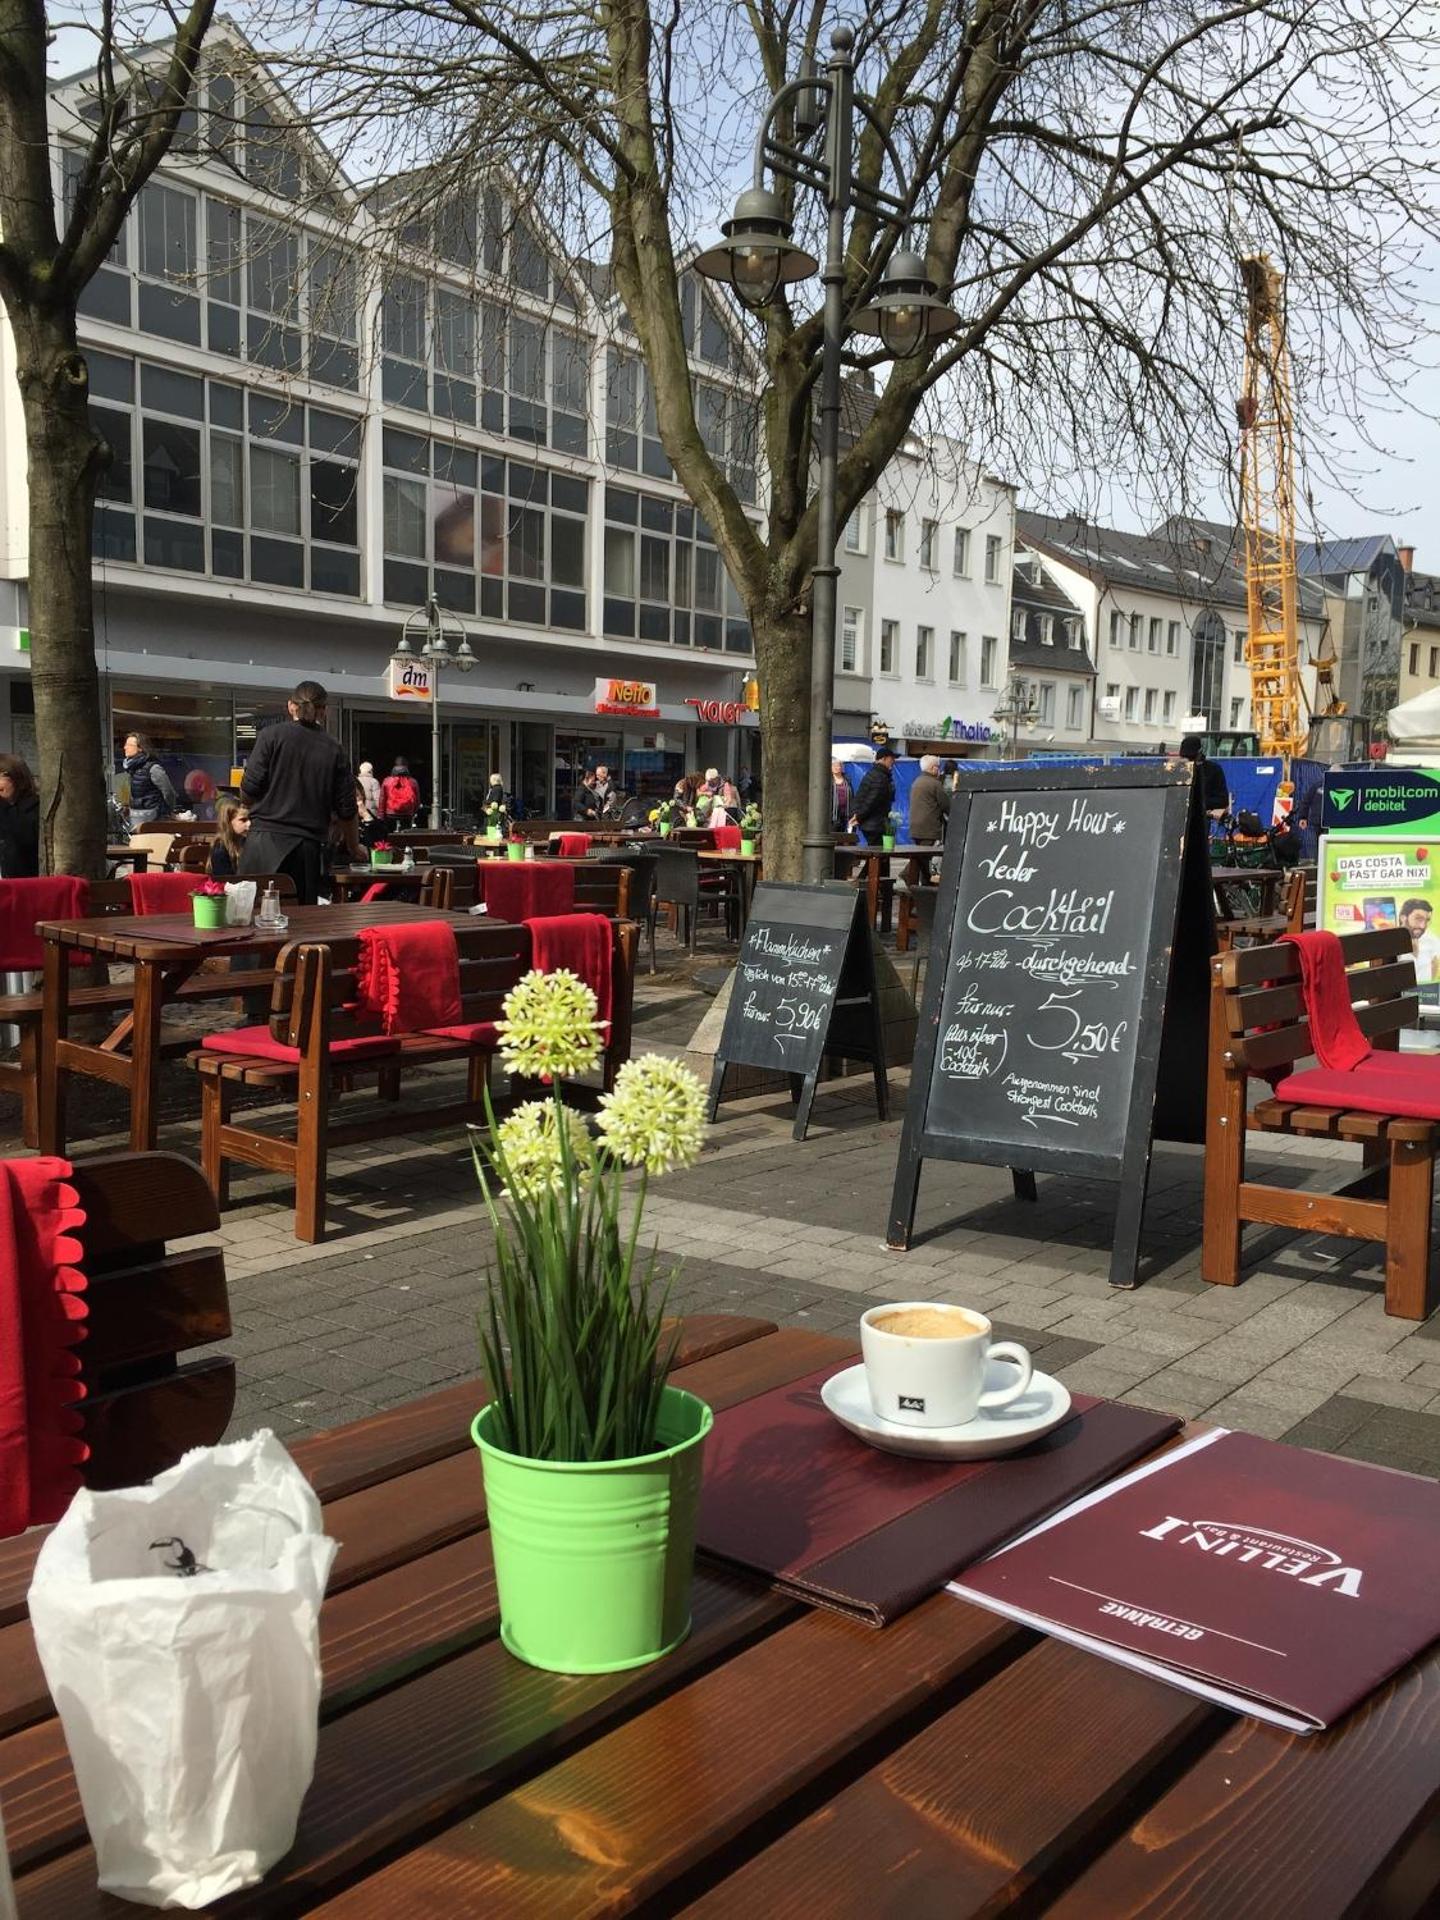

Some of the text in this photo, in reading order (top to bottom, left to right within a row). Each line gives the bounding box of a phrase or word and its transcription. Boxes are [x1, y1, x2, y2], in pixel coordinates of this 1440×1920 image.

[402, 665, 427, 686] dm
[608, 680, 652, 704] Netto
[1365, 786, 1438, 798] mobilcom
[1364, 799, 1406, 811] debitel
[999, 798, 1119, 849] Happy Hour
[1340, 856, 1402, 869] DAS COSTA
[1349, 867, 1428, 879] FAST GAR NIX!
[967, 888, 1115, 936] Cocktail
[1202, 1525, 1228, 1537] Bar
[1139, 1516, 1364, 1598] VELLINI
[1242, 1536, 1321, 1563] Restaurant
[1099, 1602, 1204, 1641] GETRÄNKE
